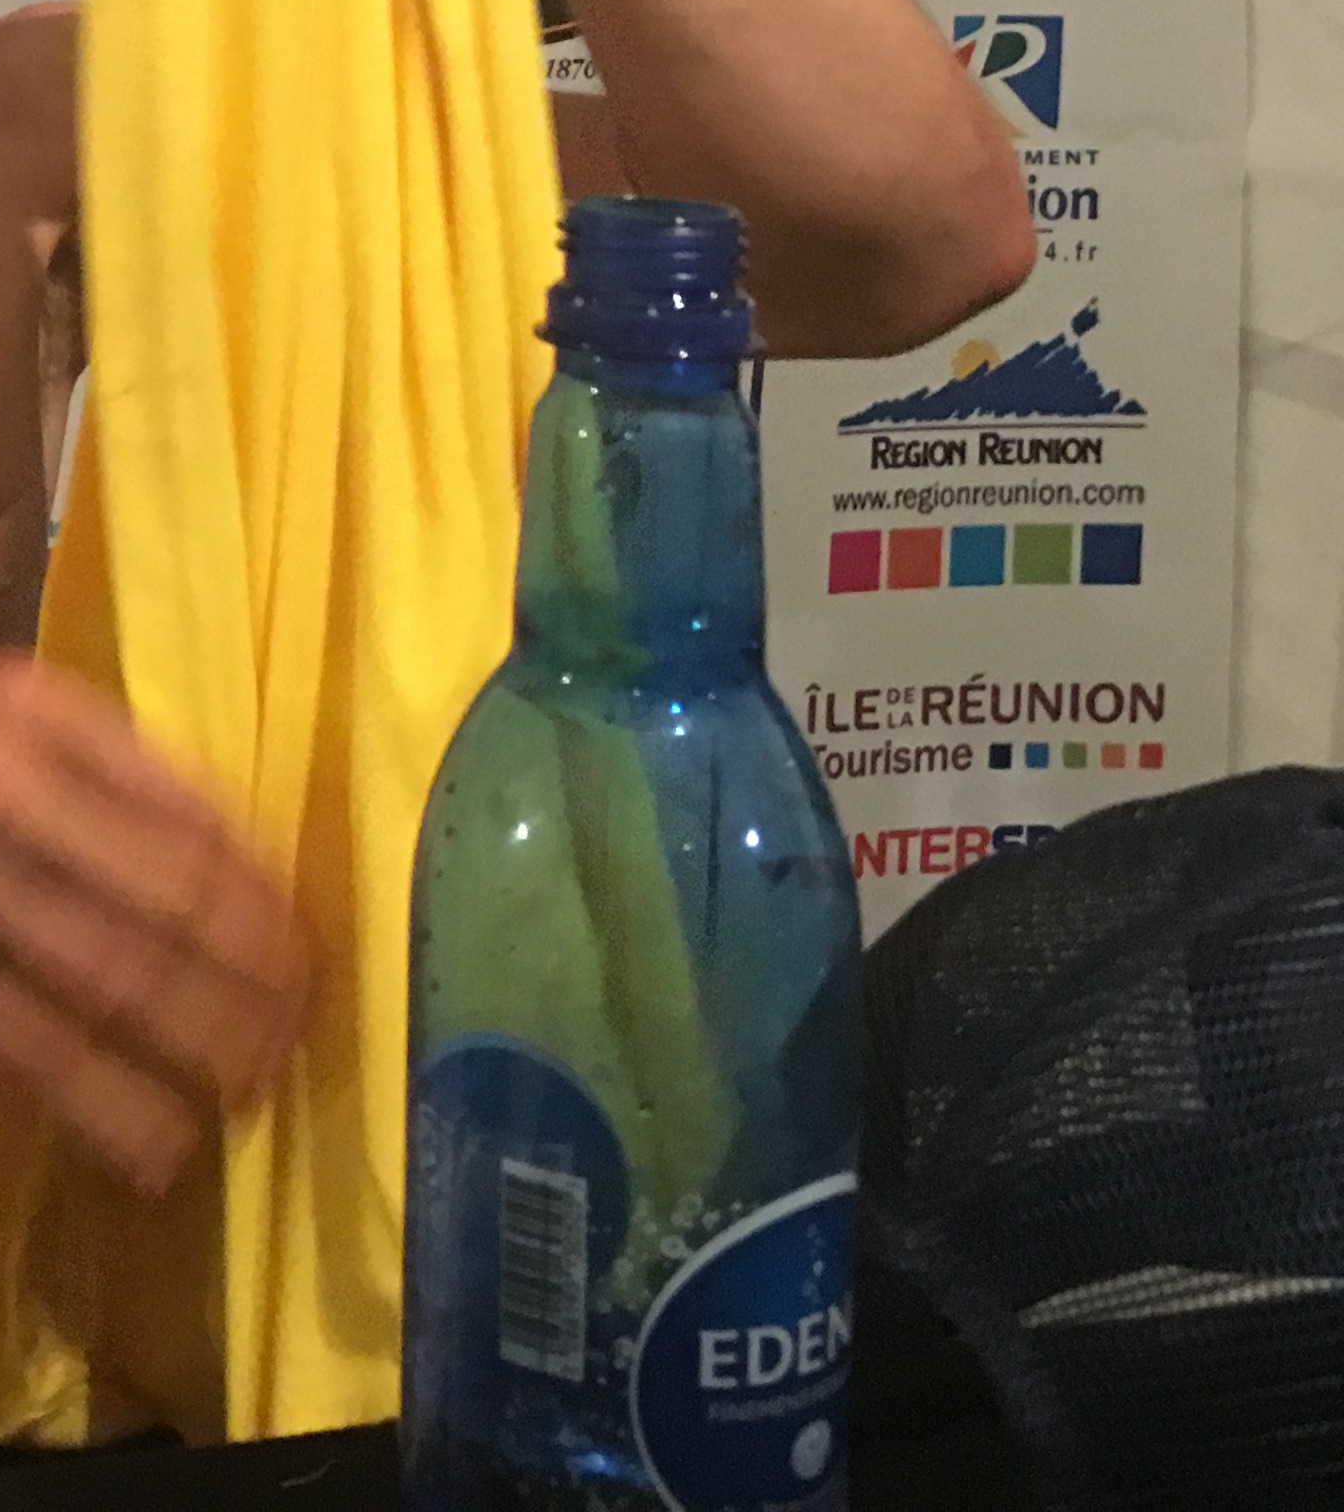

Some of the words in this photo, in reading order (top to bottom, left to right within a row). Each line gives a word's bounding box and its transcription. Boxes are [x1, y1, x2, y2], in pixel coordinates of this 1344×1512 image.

[871, 436, 966, 470] REGION
[979, 433, 1103, 466] REUNION
[833, 478, 1145, 515] www.regionreunion.com
[806, 683, 882, 735] ÎLE
[886, 686, 916, 705] DE
[921, 674, 1166, 726] RÉUNION
[887, 711, 914, 730] LA
